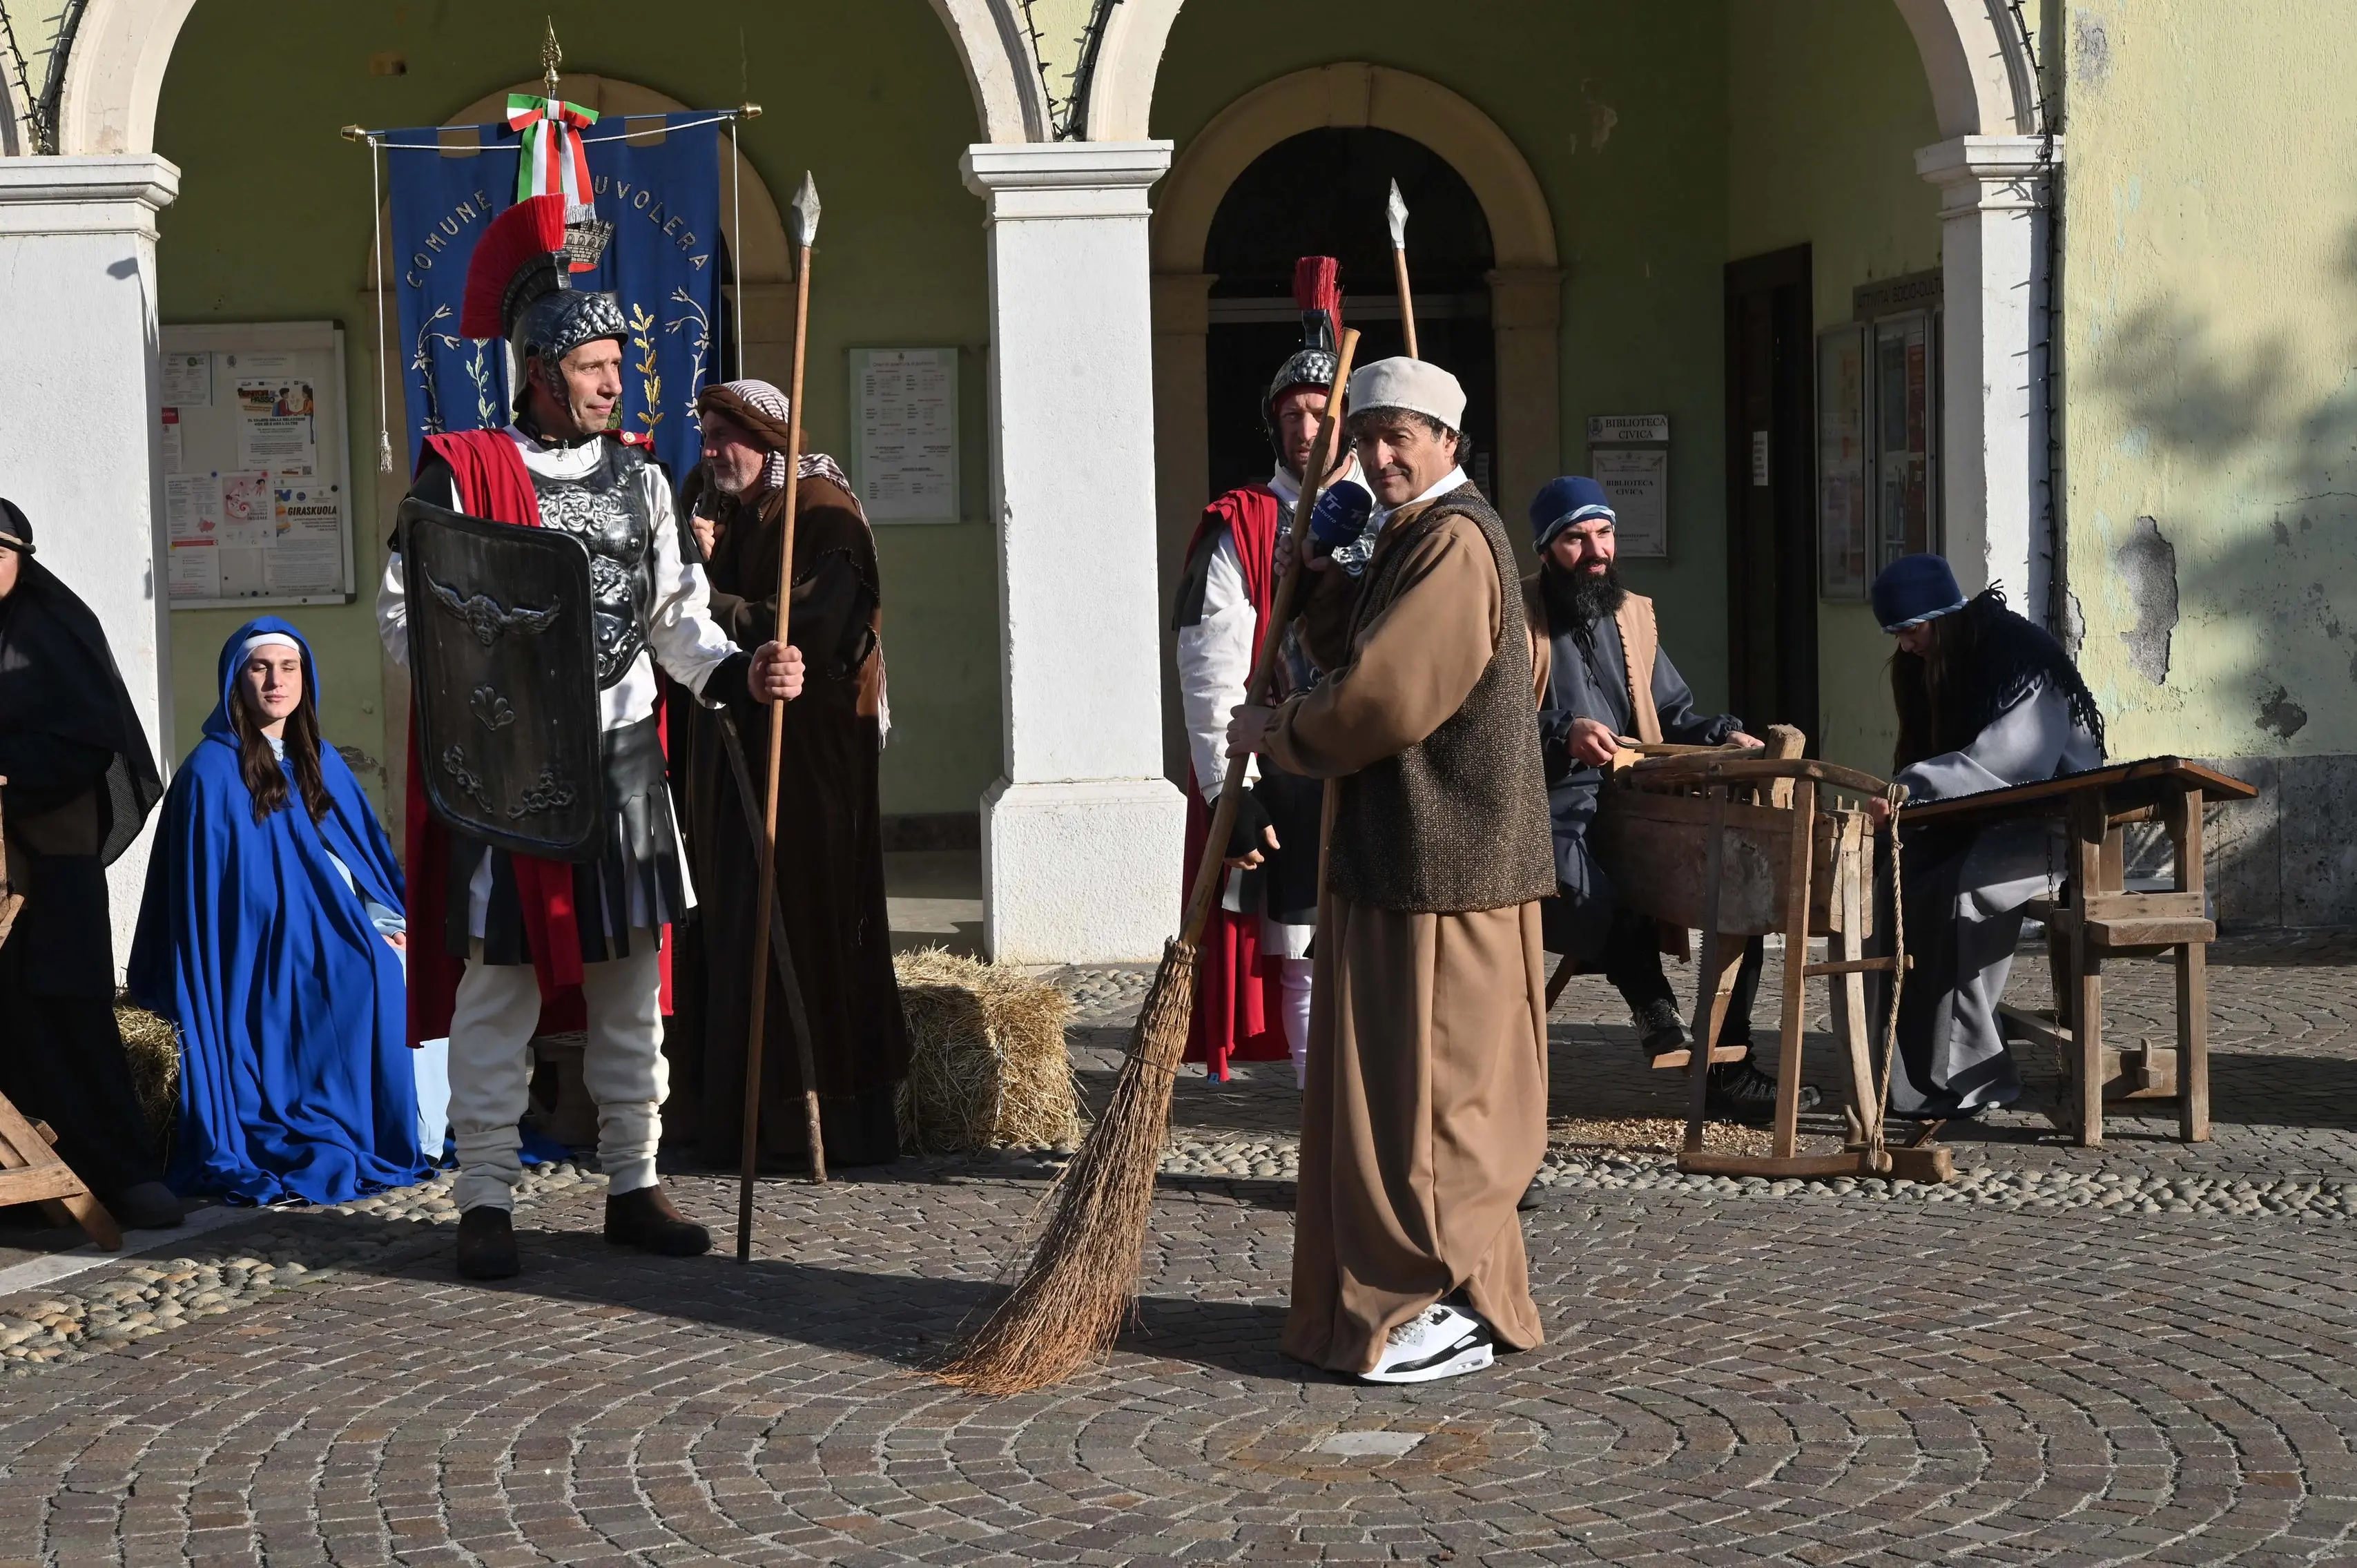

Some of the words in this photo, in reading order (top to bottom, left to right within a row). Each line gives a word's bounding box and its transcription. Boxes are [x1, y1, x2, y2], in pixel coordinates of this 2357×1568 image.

[406, 188, 492, 289] COMUNE
[595, 175, 710, 271] UVOLERA
[1892, 276, 1944, 303] SOCIO-CULTU
[1606, 418, 1667, 427] BIBLIOTECA
[1618, 430, 1653, 439] CIVICA
[288, 505, 337, 516] GIRASKUOLA
